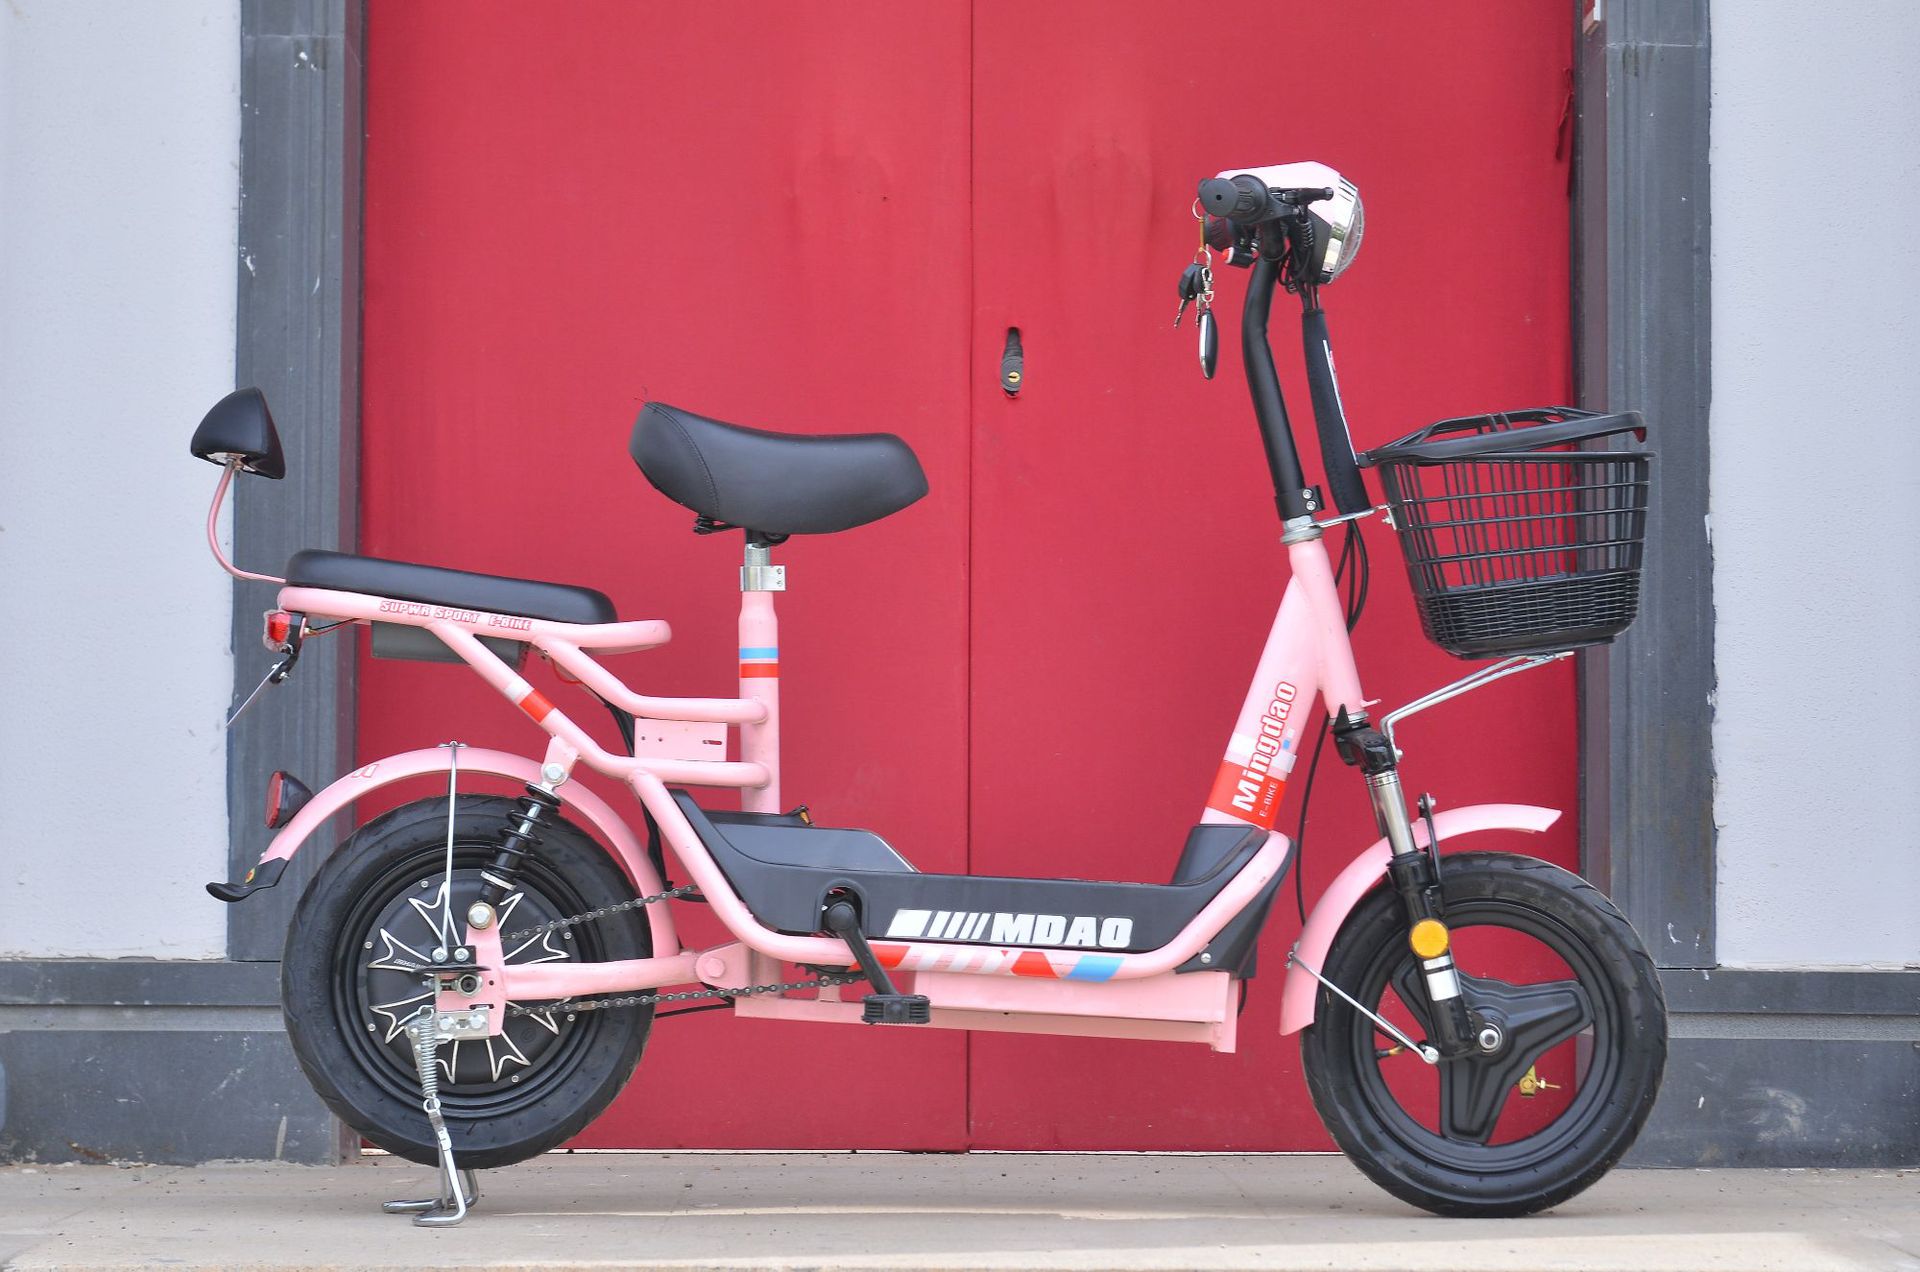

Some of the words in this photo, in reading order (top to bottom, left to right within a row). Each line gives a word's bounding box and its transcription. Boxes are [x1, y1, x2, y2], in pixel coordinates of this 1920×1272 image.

[433, 606, 480, 623] SPORT
[488, 614, 533, 631] E-BIKE
[1231, 681, 1297, 812] Mingdao
[1259, 781, 1279, 817] E-BIKE
[989, 912, 1134, 949] MDAO
